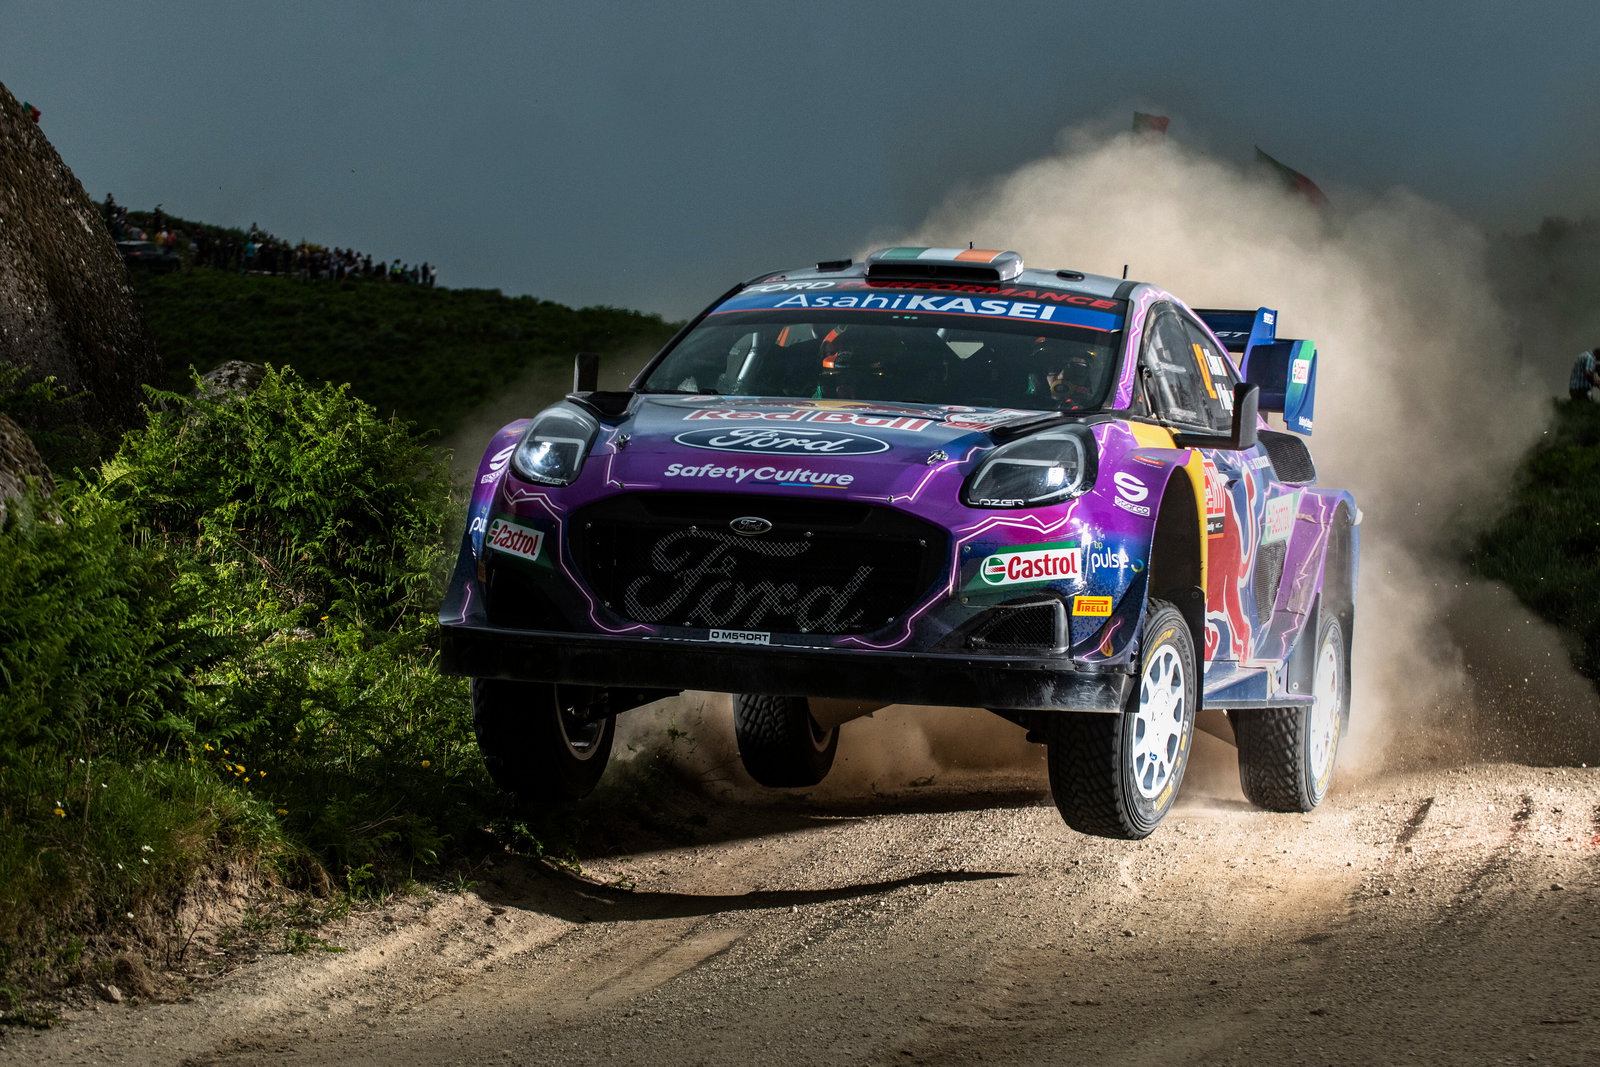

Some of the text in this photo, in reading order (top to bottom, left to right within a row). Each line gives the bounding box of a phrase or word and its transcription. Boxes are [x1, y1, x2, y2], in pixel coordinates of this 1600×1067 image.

[740, 281, 835, 294] FORD
[836, 281, 1118, 309] PERFORMANCE
[682, 409, 934, 432] Red Bull
[708, 427, 854, 452] Ford
[664, 463, 854, 484] SafetyCulture
[1115, 497, 1149, 516] sparco
[738, 518, 763, 531] Ford
[493, 524, 539, 556] Castrol
[1007, 552, 1078, 580] Castrol
[1091, 547, 1130, 573] pulse
[624, 529, 875, 633] Ford
[1077, 600, 1109, 613] PIRELLI
